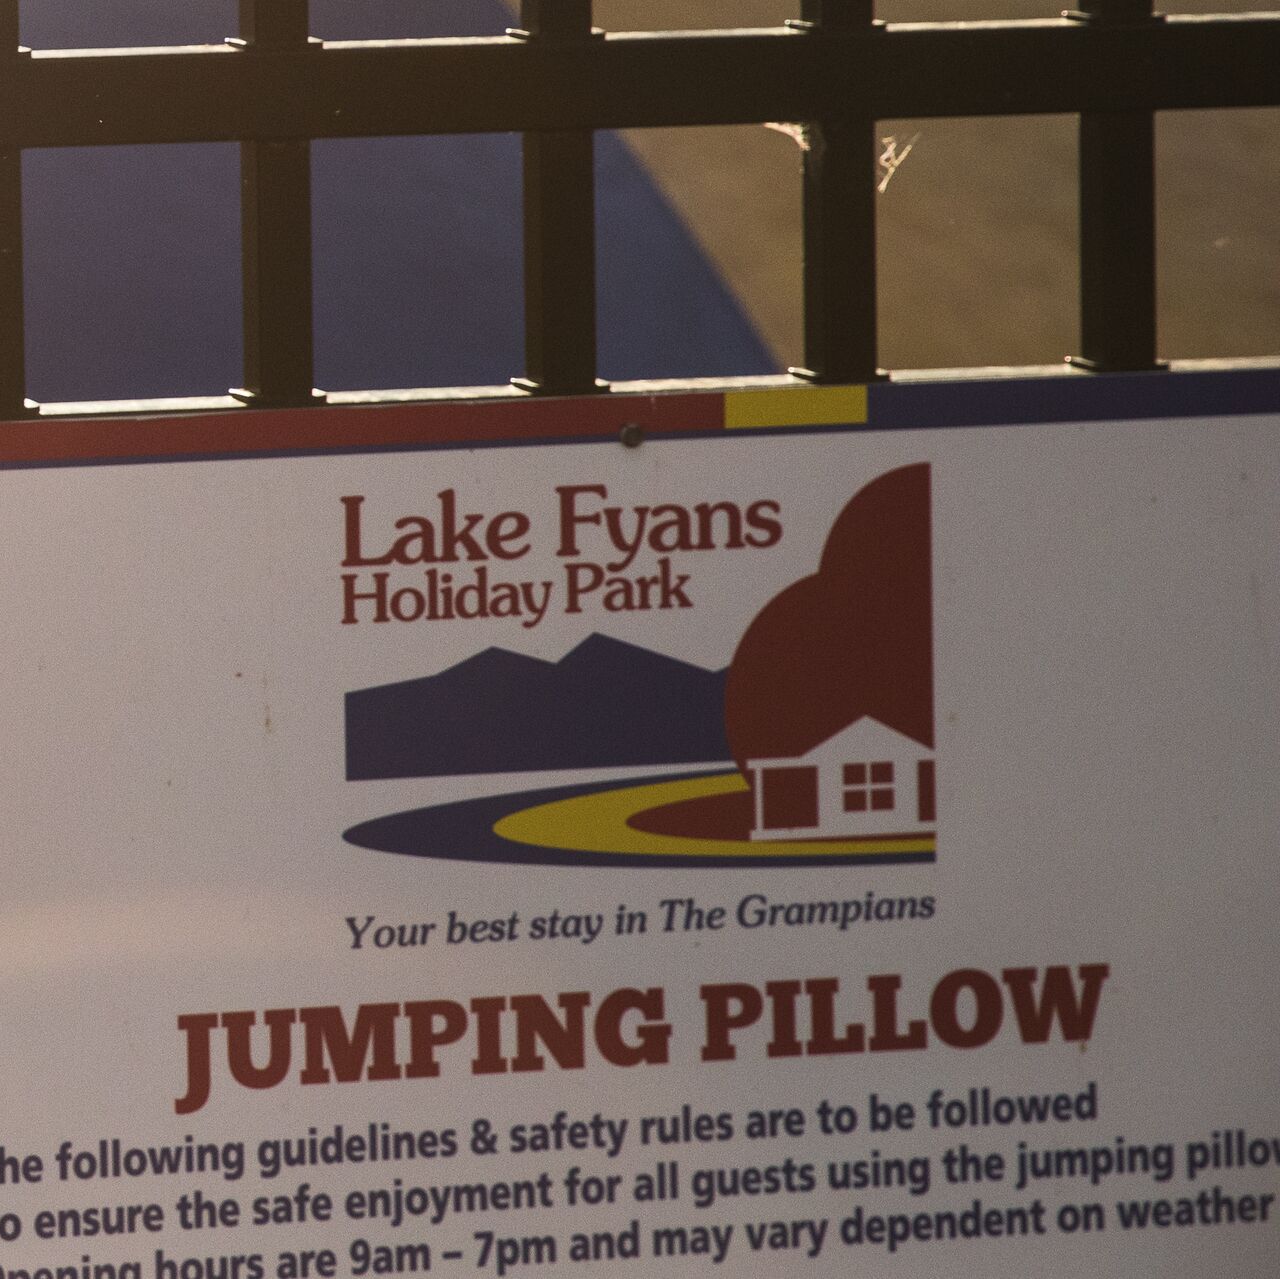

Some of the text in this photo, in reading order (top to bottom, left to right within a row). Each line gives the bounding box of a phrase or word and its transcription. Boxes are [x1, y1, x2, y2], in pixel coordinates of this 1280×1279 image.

[340, 484, 783, 573] Lake Fyans
[341, 557, 693, 629] Holiday Park
[346, 892, 935, 949] Your best stay in The Grampians
[174, 963, 1110, 1115] JUMPING PILLOW
[55, 1135, 245, 1181] following
[257, 1123, 458, 1179] guidelines
[470, 1118, 497, 1155] &
[510, 1111, 628, 1158] safety
[641, 1104, 734, 1145] rules
[745, 1109, 805, 1139] are
[816, 1100, 858, 1135] to
[869, 1094, 915, 1132] be
[926, 1082, 1098, 1129] followed
[34, 1204, 164, 1239] ensure
[176, 1190, 240, 1230] the
[253, 1183, 333, 1226] safe
[345, 1173, 553, 1227] enjoyment
[564, 1166, 622, 1206] for
[633, 1161, 679, 1202] all
[692, 1158, 816, 1209] guests
[828, 1150, 931, 1196] using
[942, 1144, 1005, 1184] the
[1016, 1136, 1175, 1190] jumping
[155, 1250, 264, 1279] hours
[277, 1249, 337, 1279] are
[349, 1239, 431, 1276] 9am
[474, 1231, 557, 1270] 7pm
[569, 1220, 640, 1262] and
[653, 1225, 733, 1264] may
[745, 1219, 828, 1258] vary
[840, 1199, 1046, 1253] dependent
[1057, 1203, 1105, 1233] on
[1116, 1186, 1275, 1230] weather
